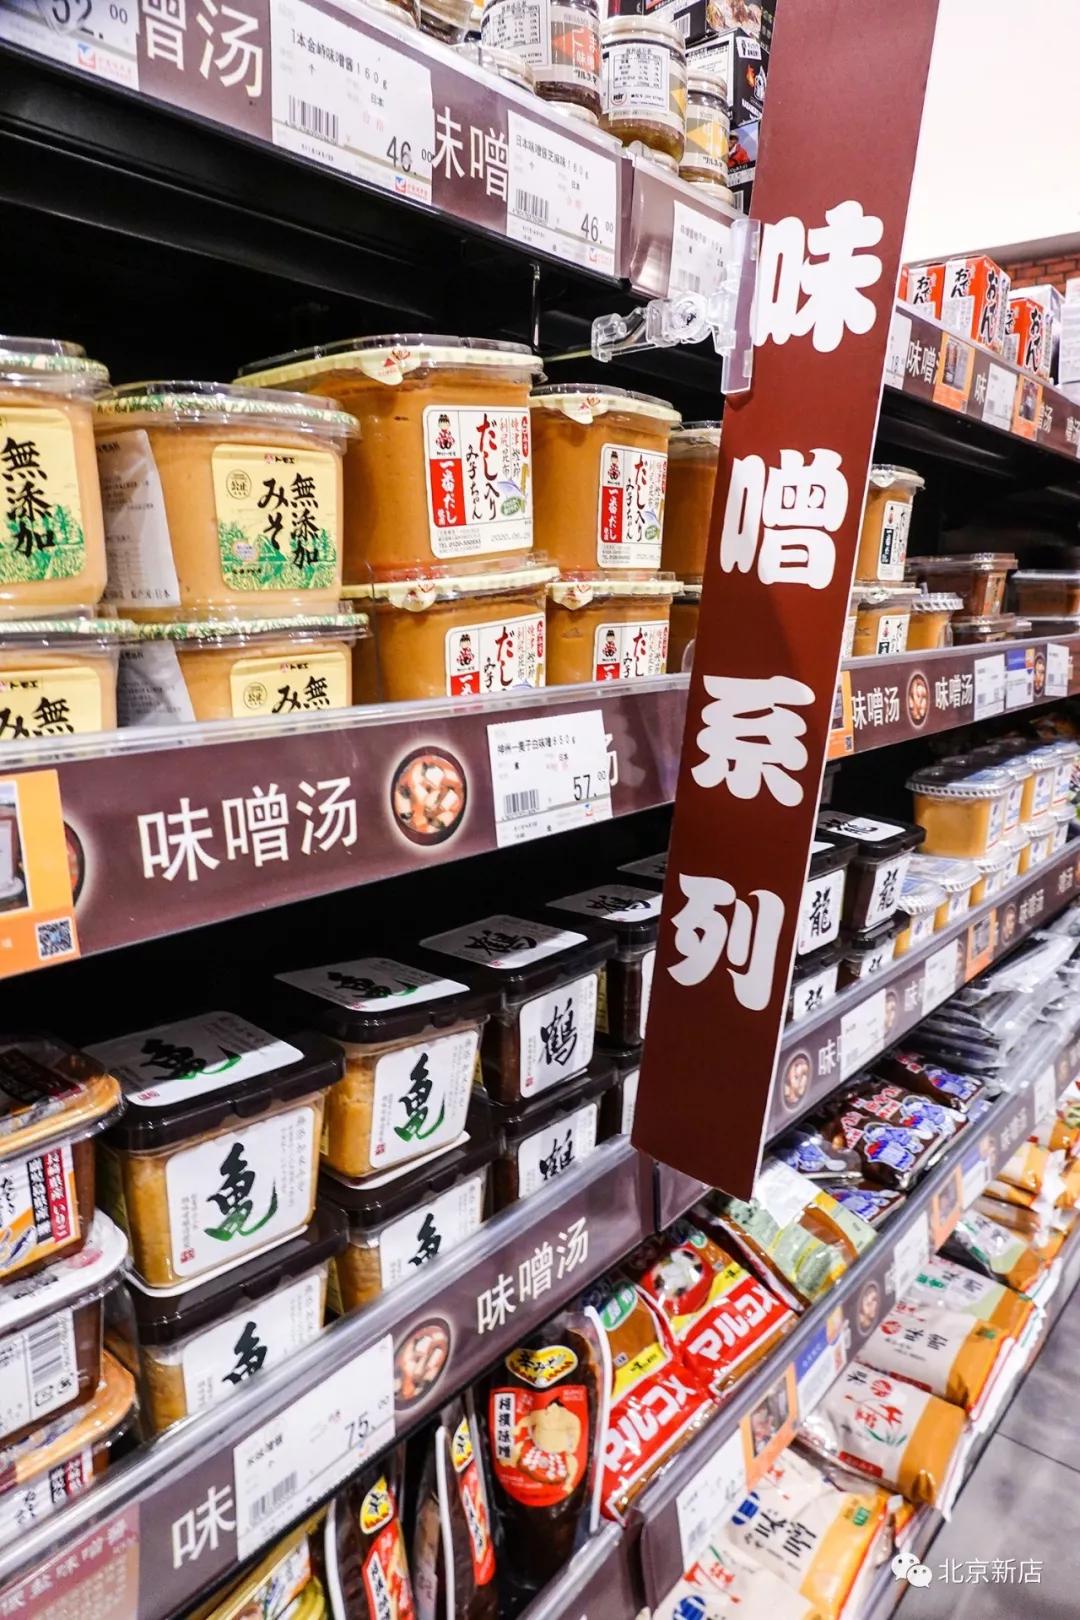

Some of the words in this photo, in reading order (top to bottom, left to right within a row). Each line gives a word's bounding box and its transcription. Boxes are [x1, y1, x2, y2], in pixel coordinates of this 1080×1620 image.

[1, 437, 56, 558] 無添加
[257, 478, 289, 550] みそ
[476, 413, 500, 521] だし入り
[291, 472, 319, 570] 無添加
[667, 200, 885, 1012] 味噌系列
[851, 686, 900, 730] 味噌汤
[935, 674, 974, 711] 味噌汤
[137, 776, 359, 882] 味噌汤
[476, 1217, 588, 1335] 味噌汤
[171, 1485, 237, 1570] 味
